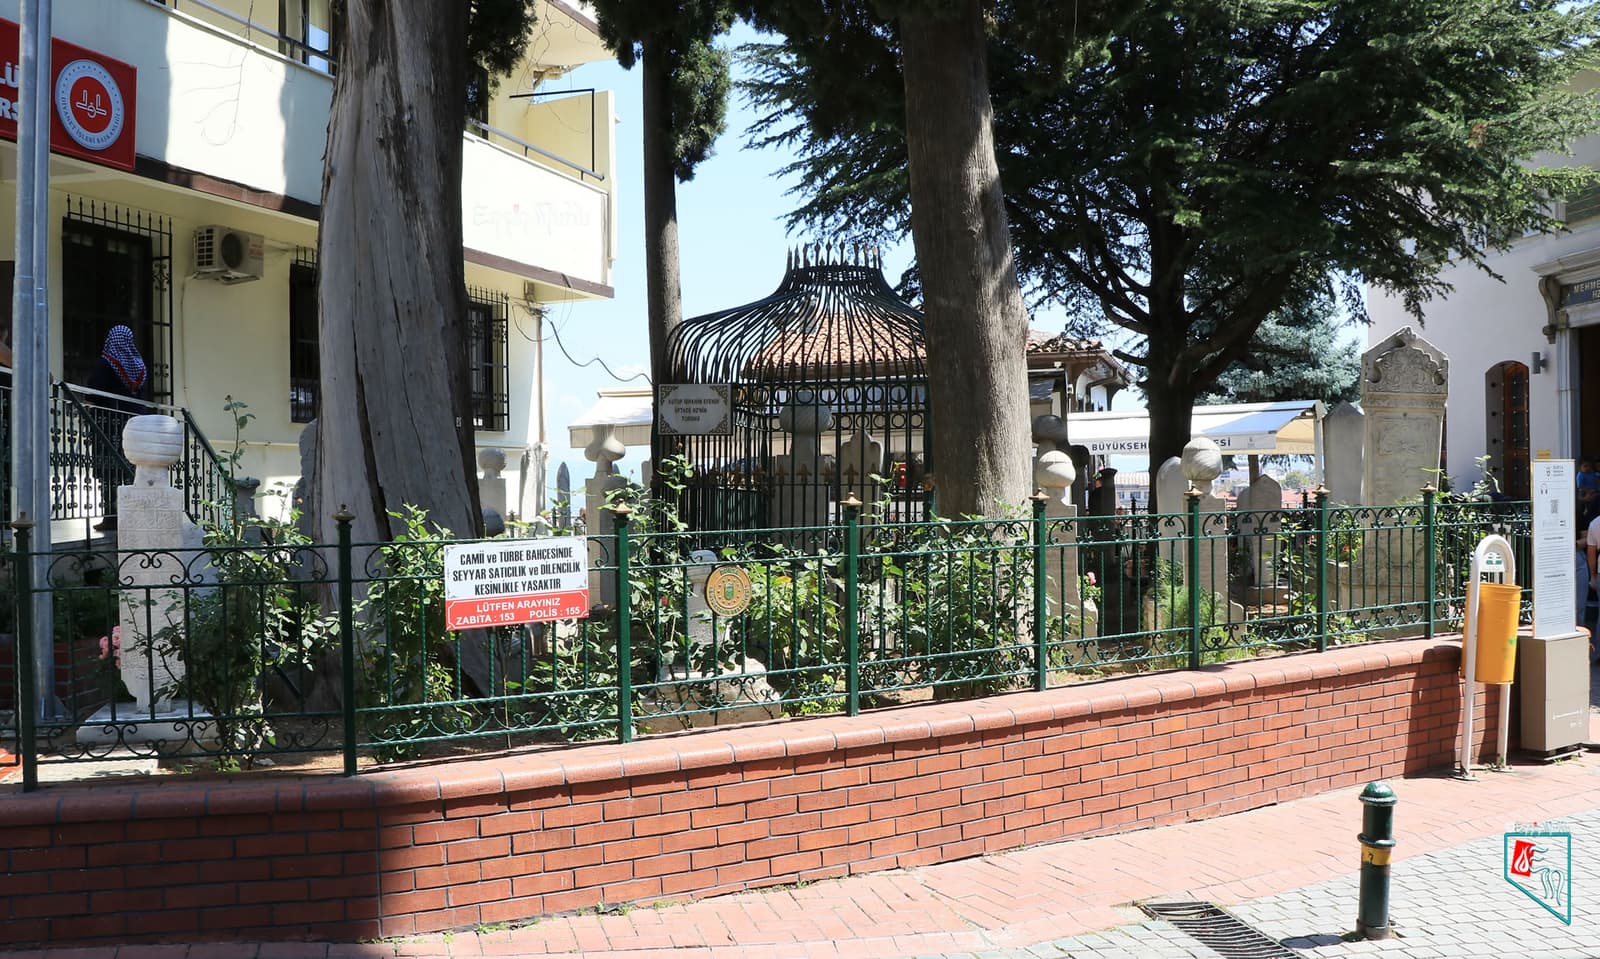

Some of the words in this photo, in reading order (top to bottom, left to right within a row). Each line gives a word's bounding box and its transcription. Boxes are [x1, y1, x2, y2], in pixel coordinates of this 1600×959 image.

[1092, 441, 1147, 452] BÜYÜKŞEH
[486, 553, 497, 564] ve
[500, 549, 524, 562] TÜRBE
[526, 546, 573, 561] BAHÇESİNDE
[453, 569, 487, 582] SEYYAR
[488, 565, 527, 579] SATICILIK
[529, 566, 539, 576] ve
[541, 560, 580, 575] DİLENCİLİK
[474, 580, 519, 596] KESİNLİKLE
[521, 578, 561, 592] YASAKTIR
[476, 601, 515, 613] LÜTFEN
[517, 597, 560, 609] ARAYINIZ
[456, 614, 492, 625] ZABITA
[500, 613, 515, 621] 153
[529, 608, 558, 618] POLİS
[565, 606, 580, 615] 155
